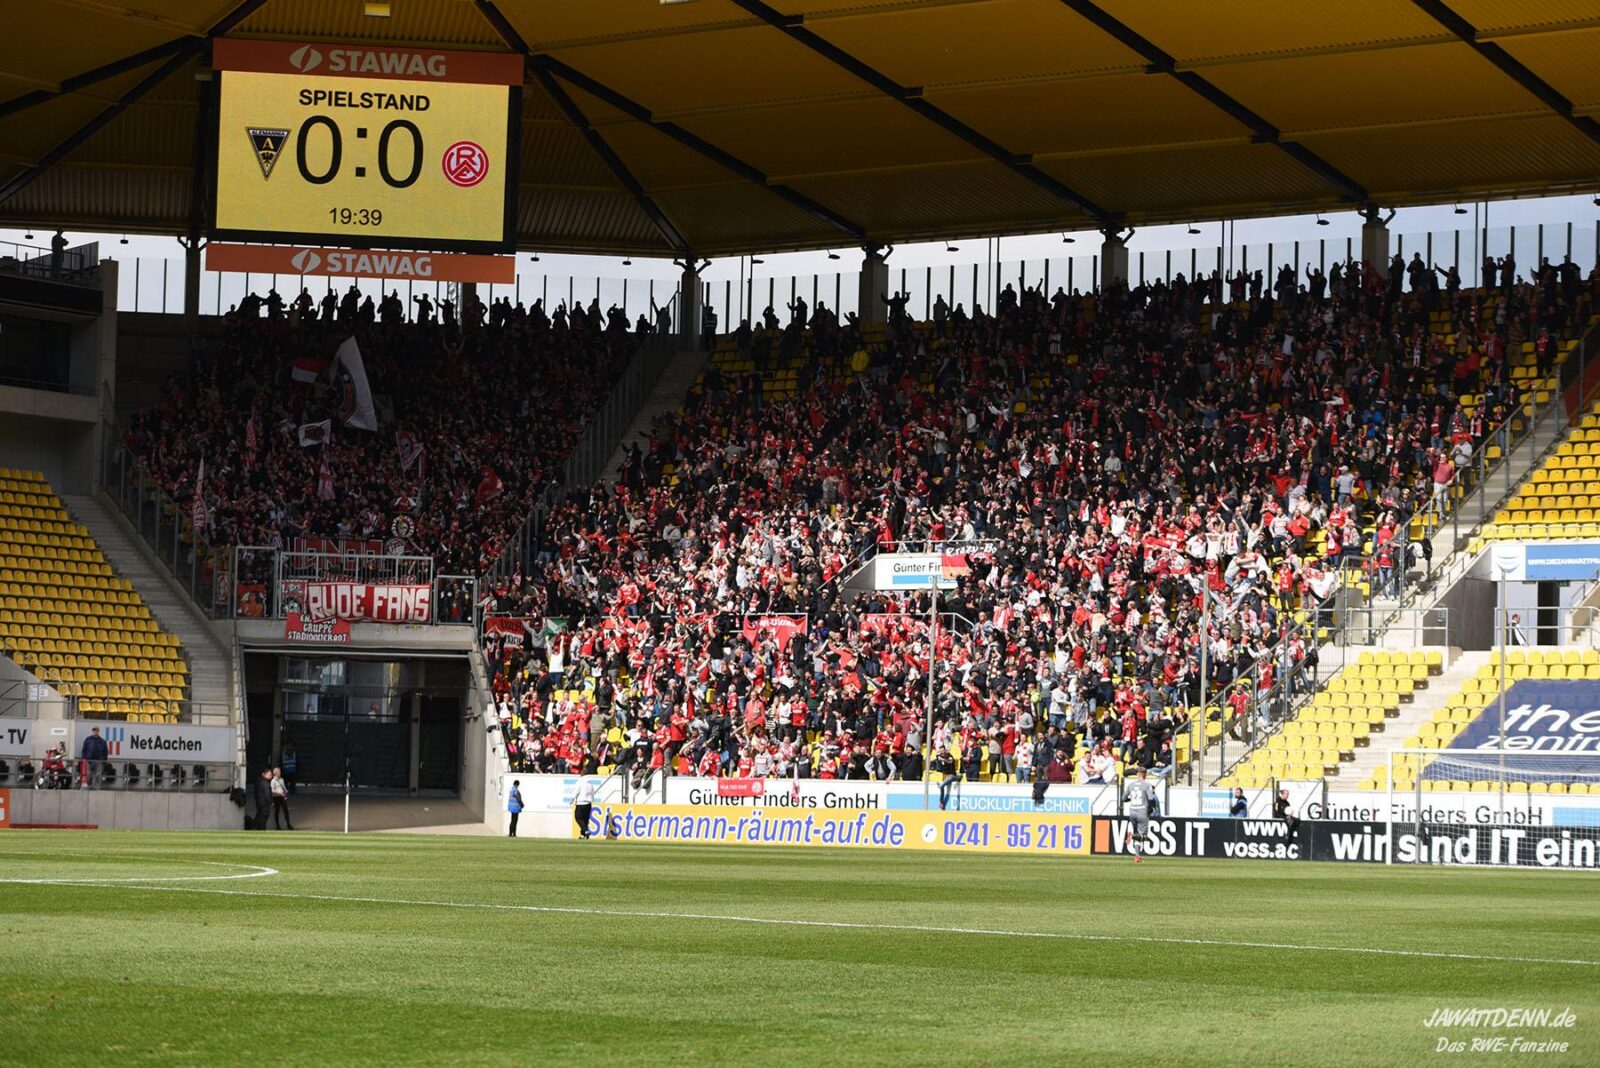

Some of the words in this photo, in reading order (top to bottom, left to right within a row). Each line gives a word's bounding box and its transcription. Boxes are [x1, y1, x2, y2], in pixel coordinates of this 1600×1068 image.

[328, 49, 446, 77] STAWAG
[299, 89, 430, 112] SPIELSTAND
[296, 115, 424, 189] 0:0
[329, 207, 382, 227] 19:39
[327, 252, 432, 278] STAWAG
[893, 561, 926, 574] Günter
[308, 584, 366, 621] RUDE
[373, 586, 429, 622] FANS
[8, 728, 28, 745] TV
[130, 734, 202, 752] NetAachen
[689, 787, 749, 808] Günter
[824, 791, 879, 810] GmbH
[588, 804, 904, 846] Sistermann-räumt-auf.de
[1307, 802, 1380, 822] Günter
[1391, 803, 1467, 824] Finders
[1475, 804, 1543, 826] GmbH
[944, 821, 989, 846] 0241
[1007, 823, 1031, 848] 95
[1037, 824, 1058, 849] 21
[1063, 825, 1083, 850] 15
[1184, 821, 1210, 856] IT
[1491, 829, 1526, 865] IT
[1223, 840, 1299, 859] voss.ac
